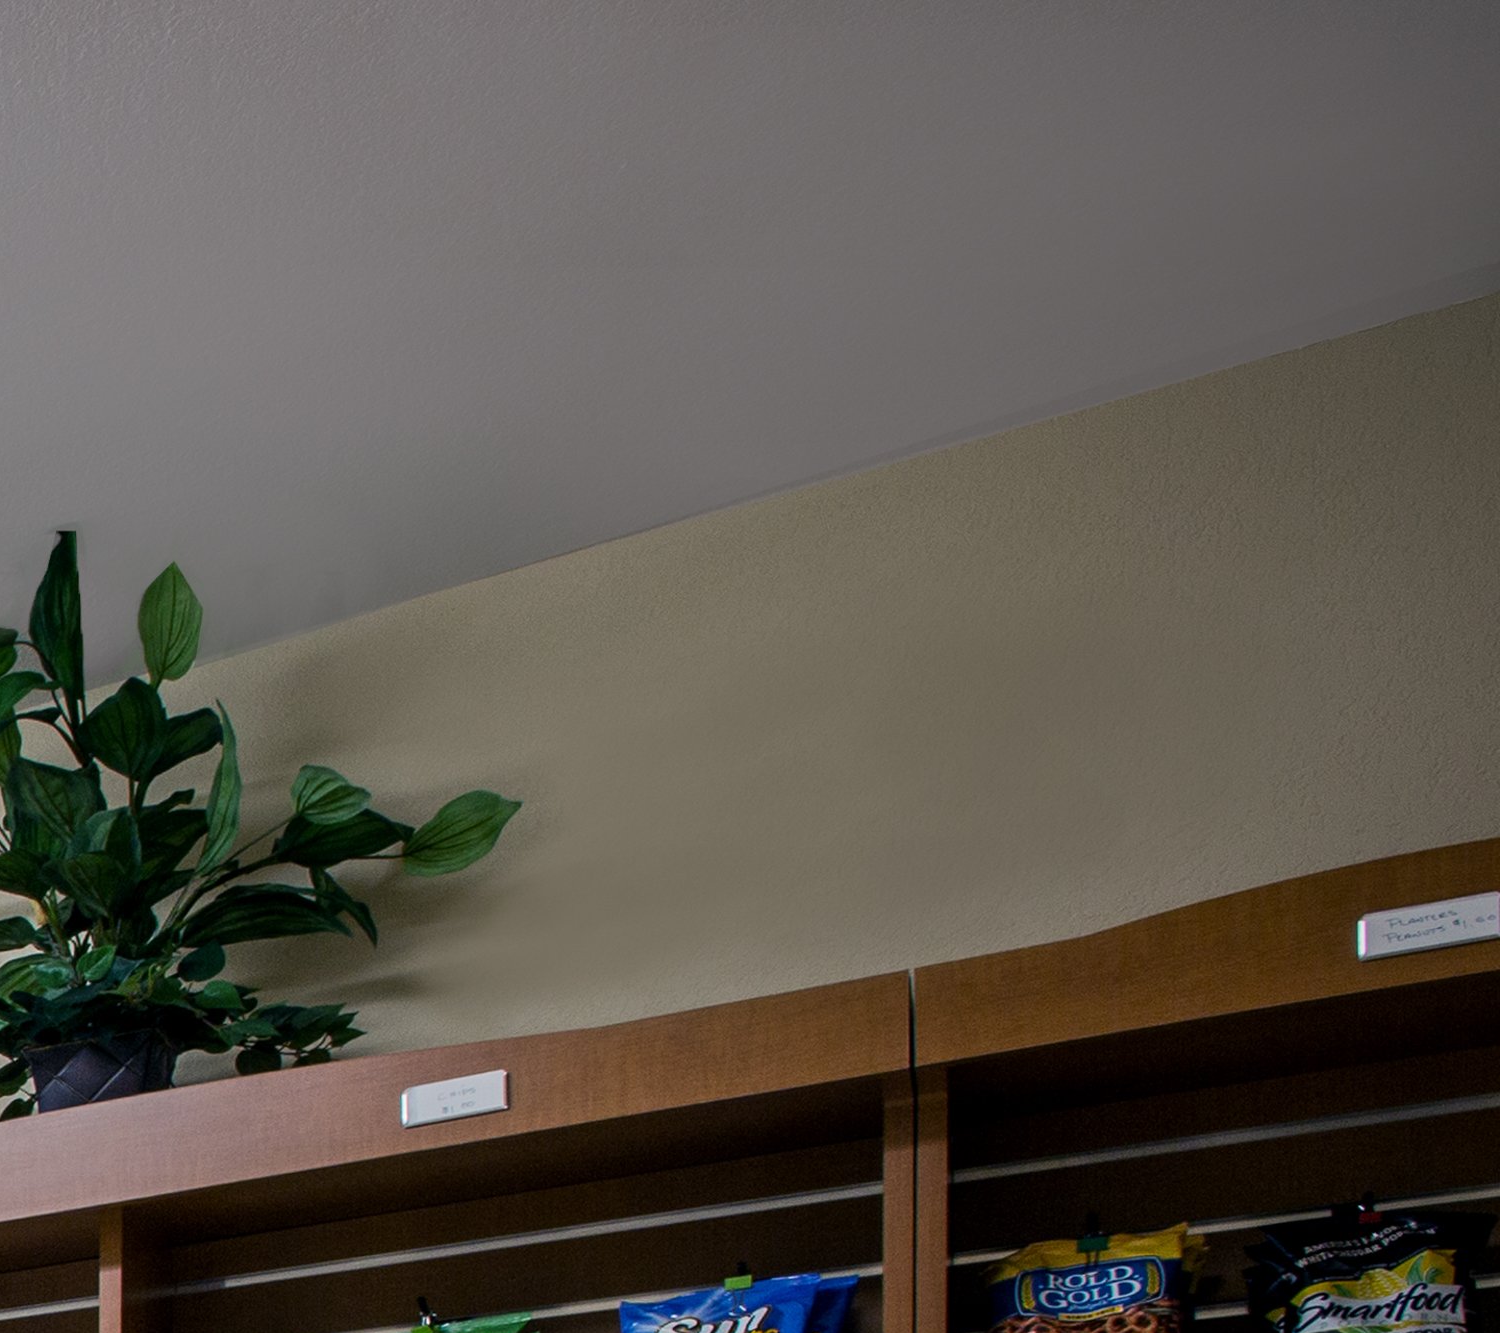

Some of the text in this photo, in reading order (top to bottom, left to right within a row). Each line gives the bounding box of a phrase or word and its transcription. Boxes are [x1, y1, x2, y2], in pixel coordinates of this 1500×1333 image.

[1048, 1265, 1136, 1291] ROLD
[1040, 1279, 1142, 1309] GOLD
[1299, 1282, 1462, 1332] Smartfood
